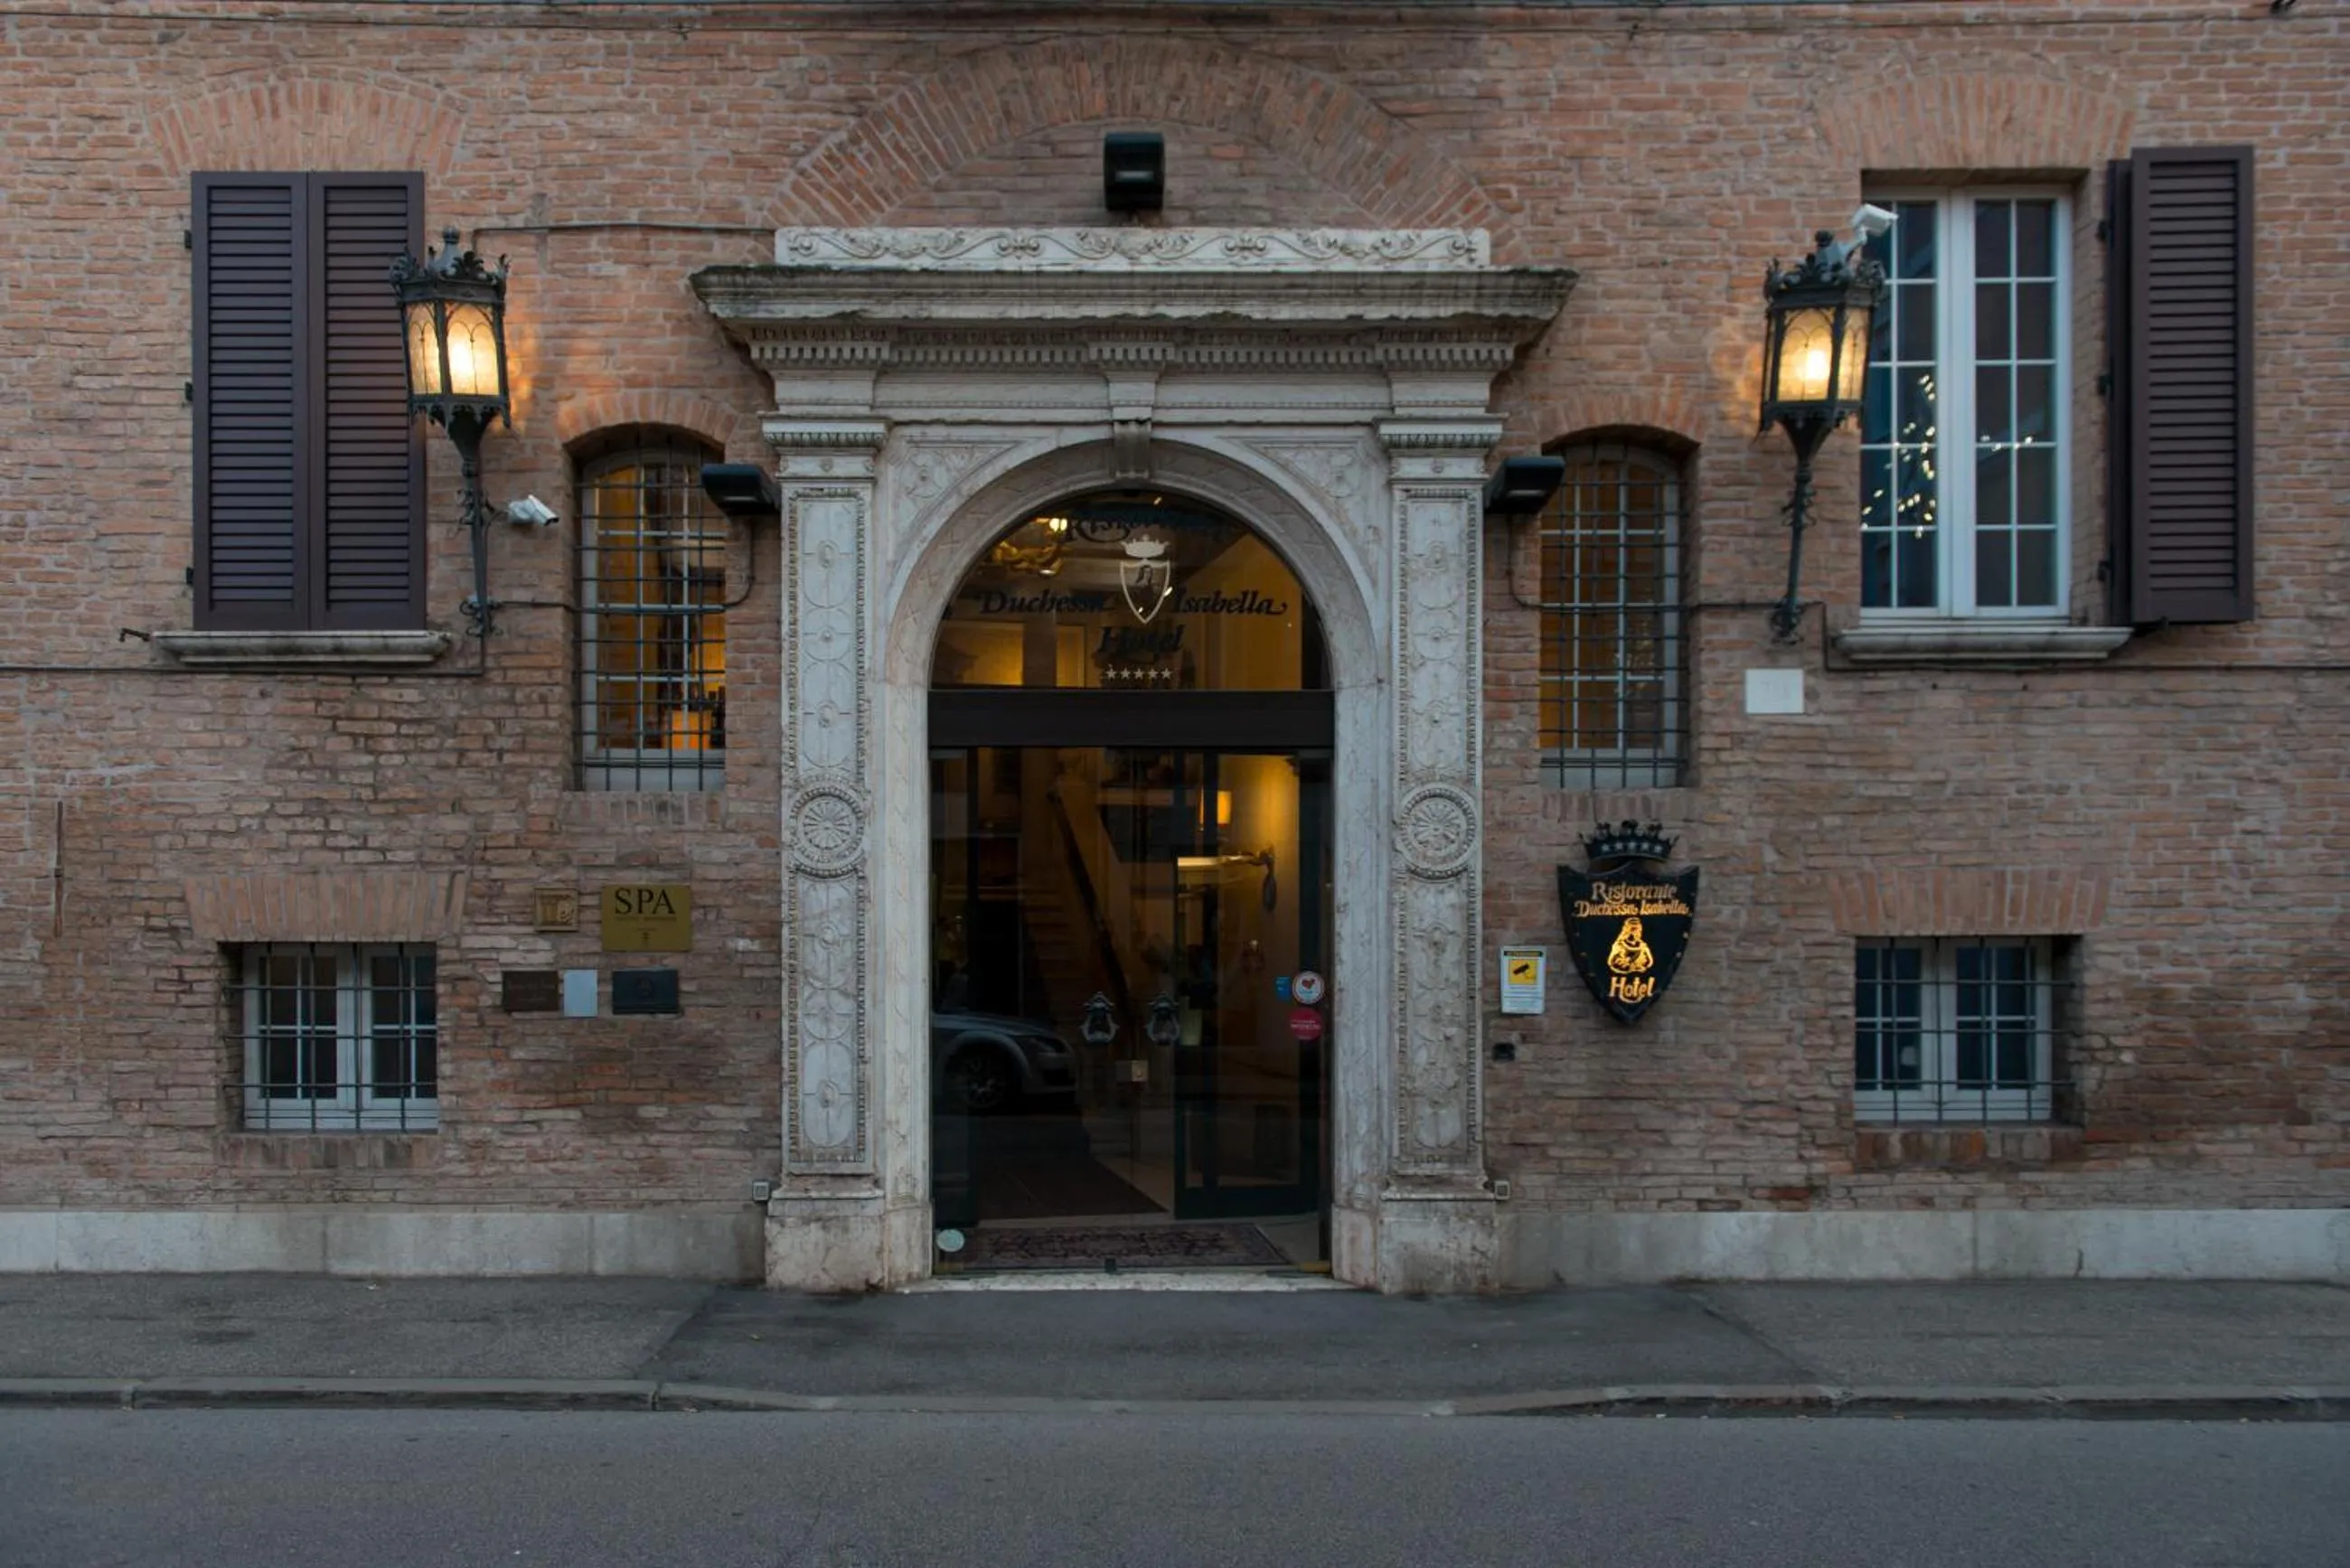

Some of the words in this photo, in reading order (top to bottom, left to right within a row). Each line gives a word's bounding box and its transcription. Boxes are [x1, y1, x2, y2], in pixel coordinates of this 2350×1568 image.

[1166, 587, 1289, 615] Isabella
[615, 887, 676, 915] SPA
[1591, 881, 1678, 904] Ristorante
[1608, 976, 1656, 1004] Hotel
